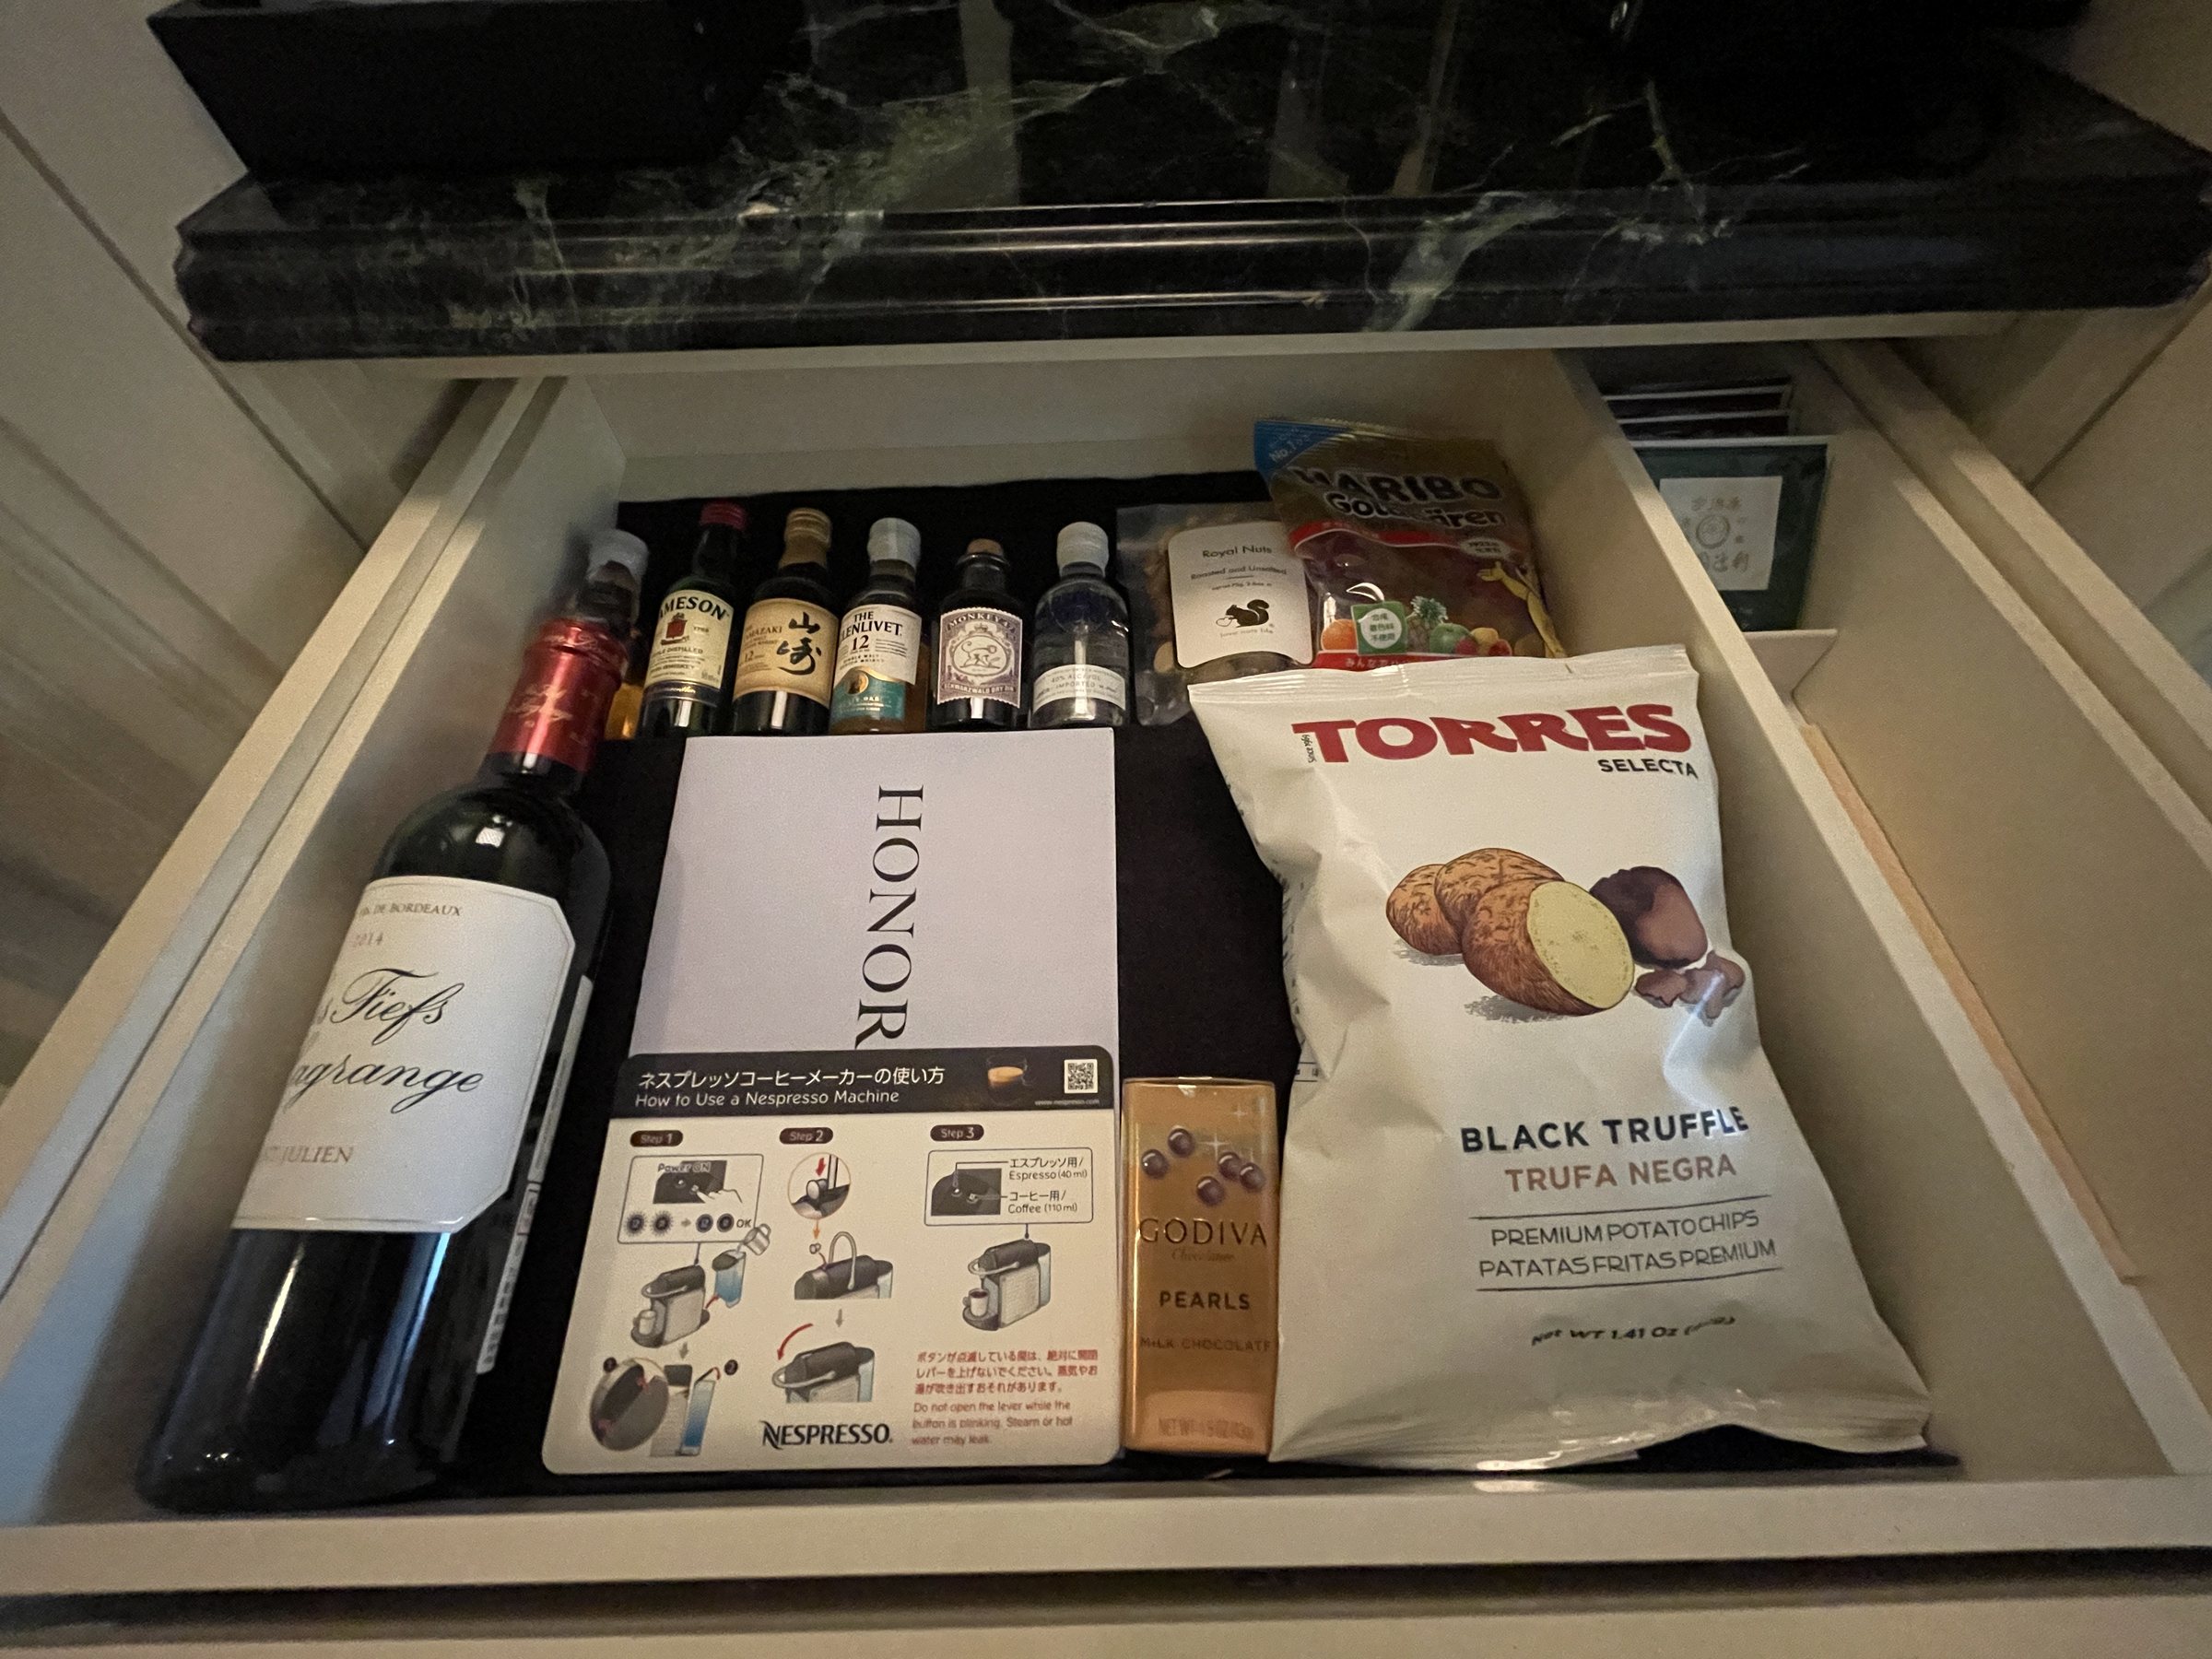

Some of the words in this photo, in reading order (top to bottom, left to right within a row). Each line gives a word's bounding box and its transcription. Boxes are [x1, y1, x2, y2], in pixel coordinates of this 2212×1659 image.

[1202, 546, 1238, 559] Royal
[1242, 545, 1273, 554] Nuts
[1190, 568, 1226, 580] Roasted
[1248, 566, 1288, 575] Unsalted
[854, 611, 874, 622] THE
[841, 620, 902, 639] LENLIVET
[777, 612, 821, 676] 山崎
[853, 635, 869, 651] 12
[1291, 703, 1691, 763] TORRES
[1597, 759, 1699, 779] SELECTA
[389, 902, 462, 916] BORDEAUX
[854, 784, 924, 1050] HONOR
[329, 968, 465, 1046] Fiefs
[281, 1053, 484, 1114] agrange
[638, 1066, 946, 1089] ネスプレッソコーヒーメーカーの使い方
[635, 1093, 670, 1108] How
[676, 1092, 690, 1106] to
[696, 1092, 725, 1106] Use
[730, 1094, 740, 1106] a
[745, 1089, 830, 1108] Nespresso
[834, 1088, 900, 1104] Machine
[789, 1131, 813, 1143] Step
[816, 1129, 824, 1142] 2
[940, 1127, 964, 1140] Step
[967, 1127, 975, 1139] 3
[1461, 1121, 1588, 1153] BLACK
[1602, 1106, 1749, 1146] TRUFFLE
[640, 1134, 664, 1145] Step
[666, 1133, 673, 1144] 1
[657, 1162, 691, 1172] Power
[693, 1162, 711, 1172] ON
[1505, 1164, 1618, 1193] TRUFA
[1629, 1153, 1737, 1185] NEGRA
[1008, 1170, 1056, 1182] Espresso
[1009, 1189, 1066, 1202] コーヒー用/
[1007, 1203, 1041, 1215] Coffee
[736, 1218, 752, 1228] OK
[1491, 1224, 1603, 1246] PREMIUM
[1608, 1218, 1698, 1241] POTATO
[1698, 1210, 1759, 1232] CHIPS
[1139, 1217, 1267, 1247] GODIVA
[1479, 1256, 1590, 1278] PATATAS
[1594, 1250, 1677, 1275] FRITAS
[1680, 1239, 1776, 1266] PREMIUM
[1159, 1291, 1251, 1311] PEARLS
[1570, 1329, 1606, 1339] WT
[1611, 1327, 1645, 1340] 1.41
[1140, 1338, 1174, 1349] MILK
[913, 1402, 928, 1413] Do
[931, 1401, 948, 1413] not
[950, 1403, 976, 1414] open
[978, 1401, 994, 1412] the
[997, 1401, 1022, 1412] lever
[1054, 1399, 1071, 1411] the
[912, 1418, 946, 1430] button
[947, 1418, 958, 1429] is
[1006, 1416, 1041, 1428] Steam
[1042, 1417, 1053, 1428] or
[1055, 1415, 1074, 1428] hot
